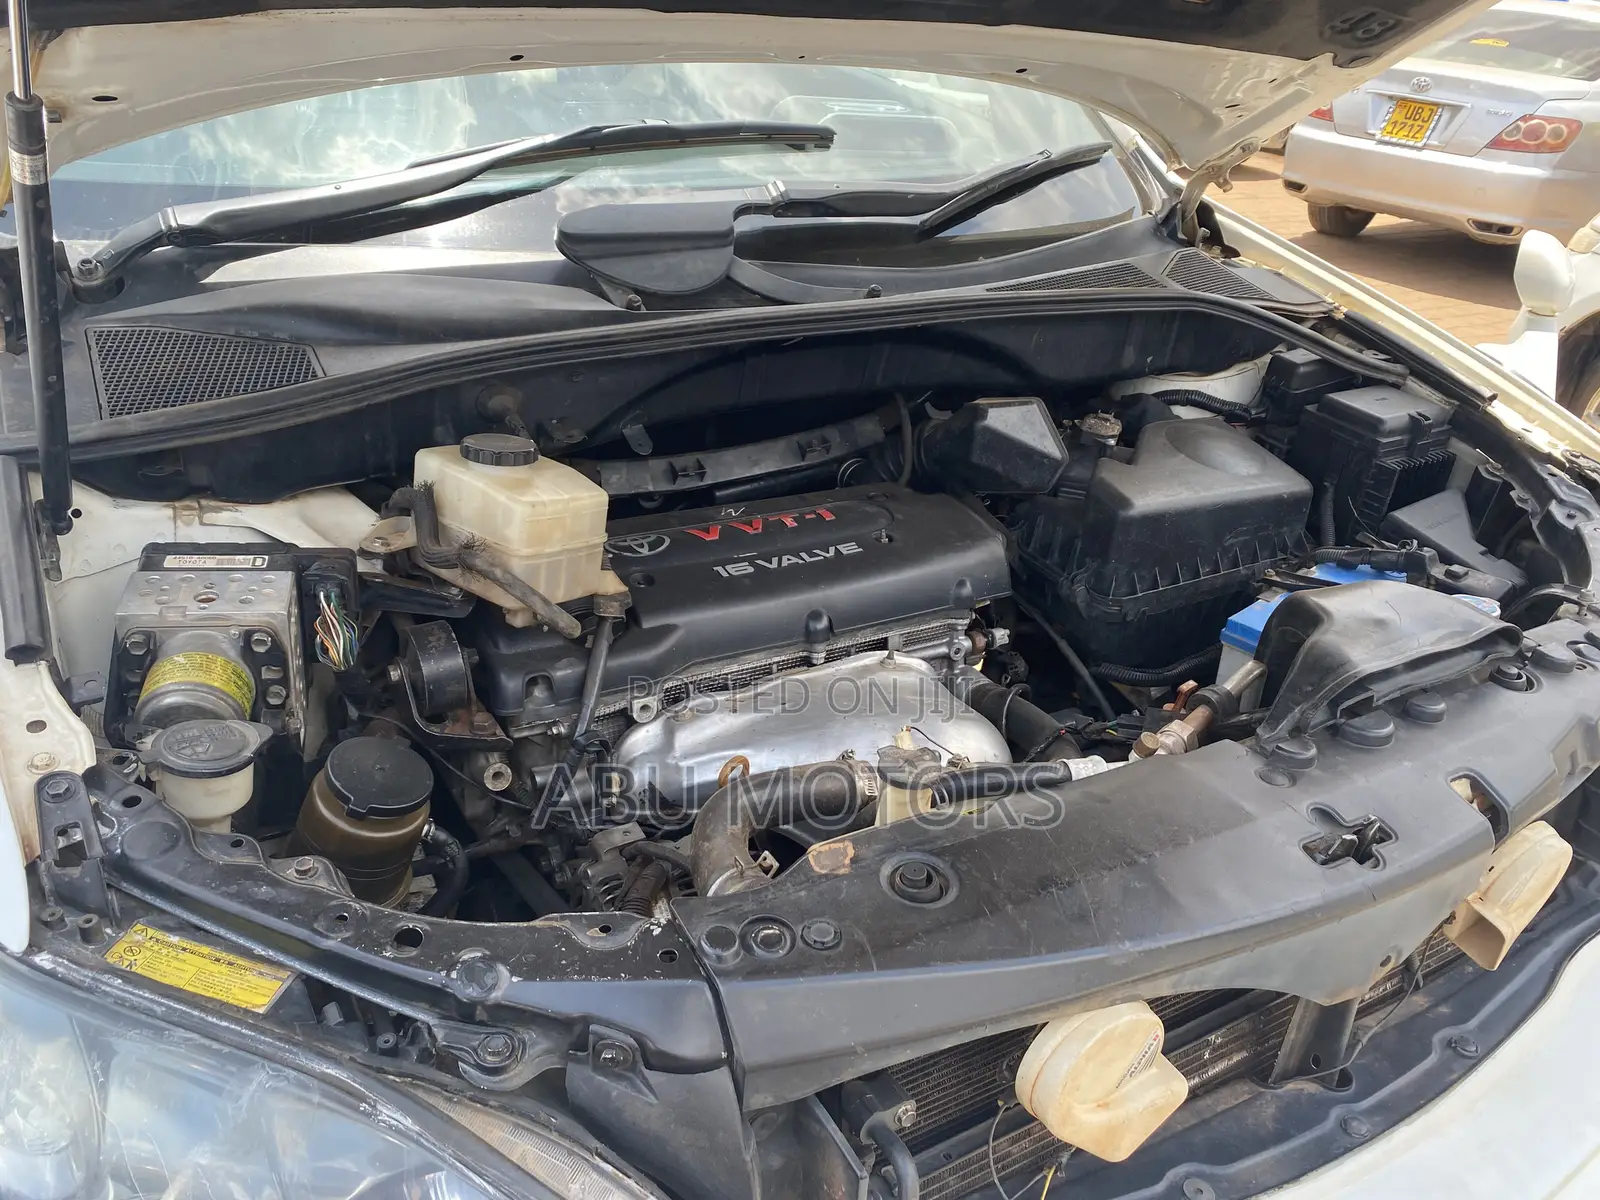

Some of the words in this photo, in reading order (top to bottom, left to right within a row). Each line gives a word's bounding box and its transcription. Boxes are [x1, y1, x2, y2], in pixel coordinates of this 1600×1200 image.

[1404, 104, 1434, 123] UBJ
[251, 556, 267, 567] D
[712, 561, 756, 578] 16
[754, 541, 864, 570] VALVE
